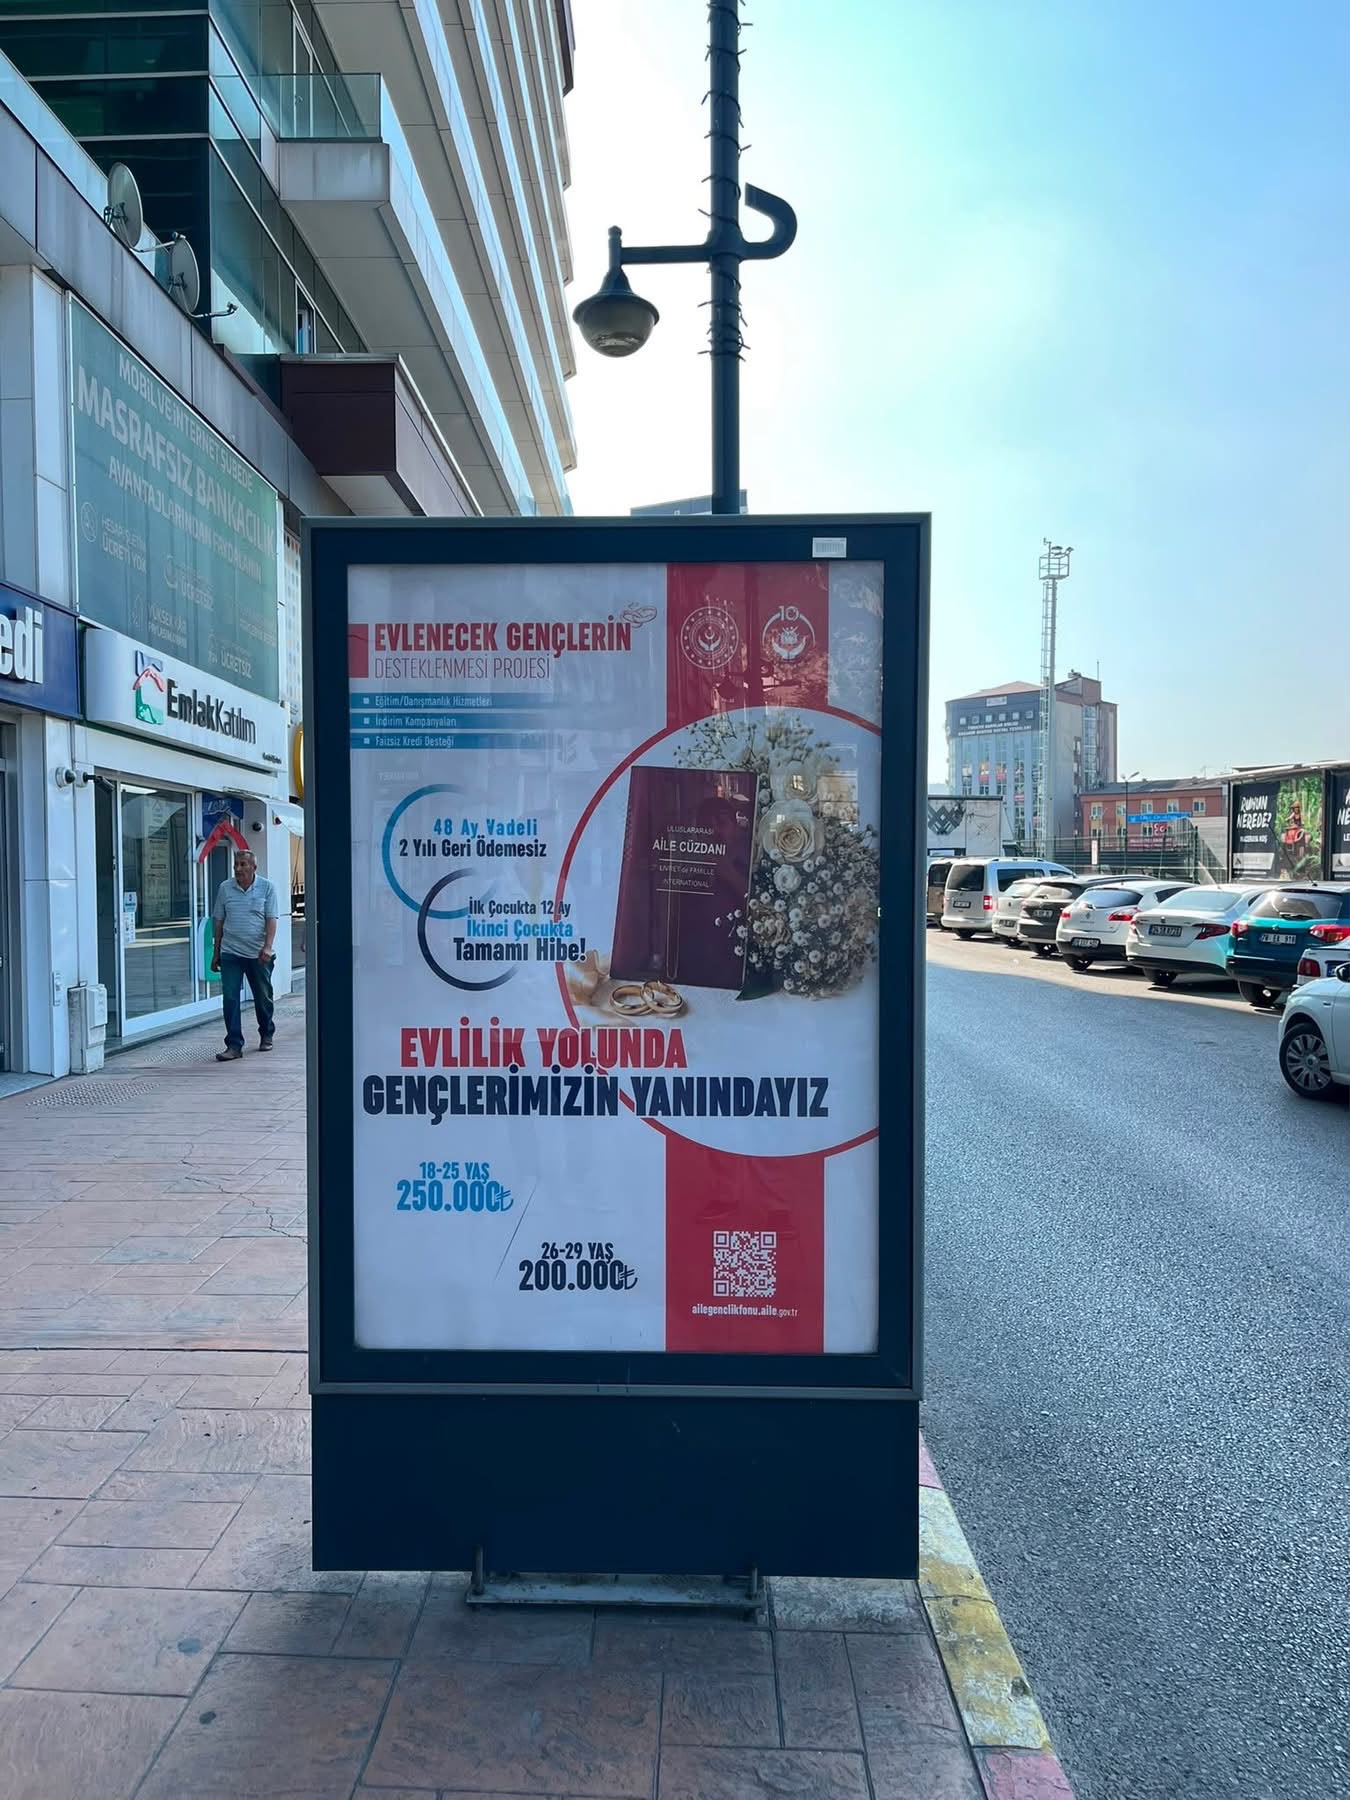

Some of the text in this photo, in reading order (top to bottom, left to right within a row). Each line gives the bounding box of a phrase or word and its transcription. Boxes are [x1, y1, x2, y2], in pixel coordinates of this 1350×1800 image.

[77, 369, 192, 493] MASRAFSIZ
[374, 615, 631, 658] EVLENECEK GENÇLERİN
[375, 653, 550, 679] DESTEKLENMESİ PROJESİ
[375, 695, 492, 708] Eğitim/Danışmanlık Hizmetleri
[375, 715, 457, 728] İndirim Kampanyaları
[375, 736, 454, 748] Faizsiz Kredi Desteği
[433, 818, 537, 839] 48 Ay Vadeli
[1236, 812, 1272, 830] NEREDE?
[399, 835, 547, 858] 2 Yılı Geri Ödemesiz
[652, 836, 726, 856] AİLE CÜZDANI
[469, 896, 571, 917] İlk Çocukta 12 Ay
[467, 915, 573, 941] İkinci Çocukta
[453, 937, 586, 961] Tamamı Hibe!
[400, 1016, 688, 1069] EVLİLİK YOLUNDA
[362, 1063, 829, 1125] GENÇLERİMİZİN YANINDAYIZ
[419, 1161, 490, 1184] 18-25 YAŞ
[541, 1242, 614, 1263] 26-29 YAŞ
[692, 1303, 798, 1318] ailegenclikfonu.aile.gov.tr
